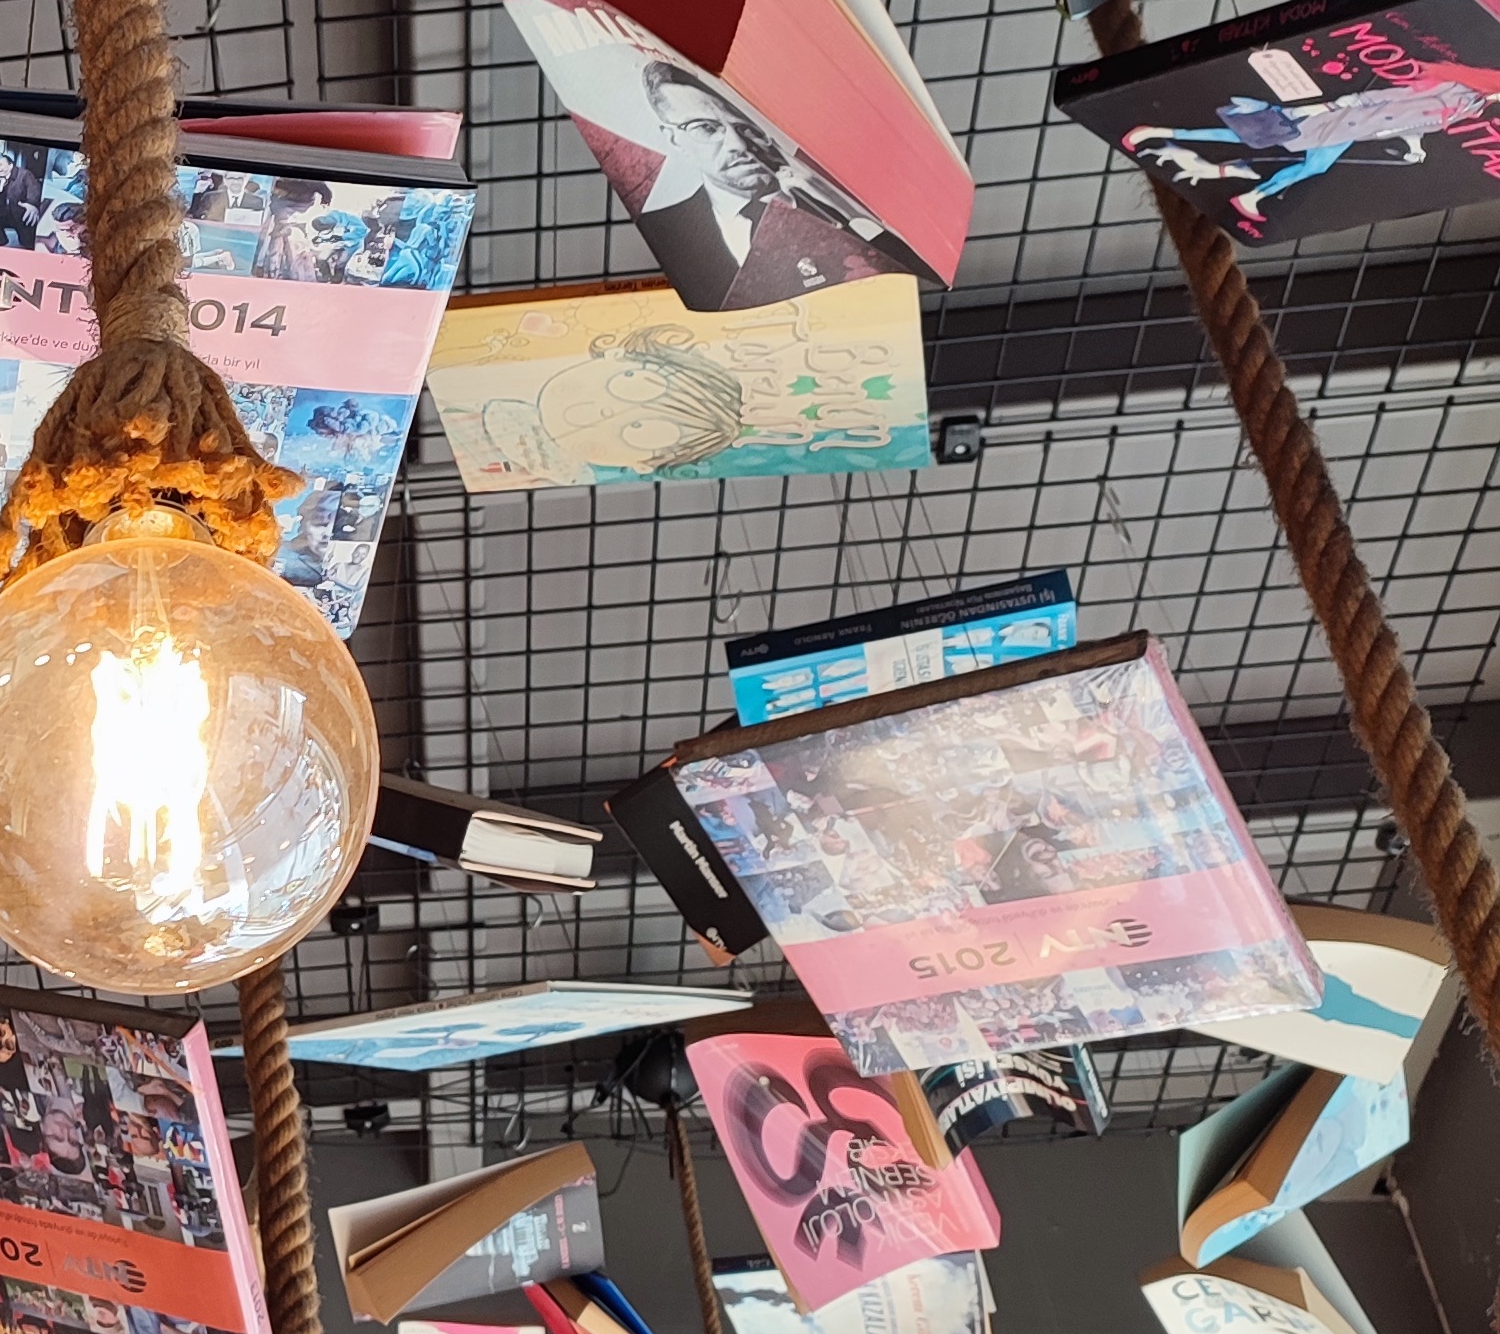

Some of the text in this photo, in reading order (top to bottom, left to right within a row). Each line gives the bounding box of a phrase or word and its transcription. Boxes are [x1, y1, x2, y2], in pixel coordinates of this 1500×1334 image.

[188, 299, 287, 338] 014
[51, 338, 70, 352] ve
[903, 939, 1014, 982] 2015
